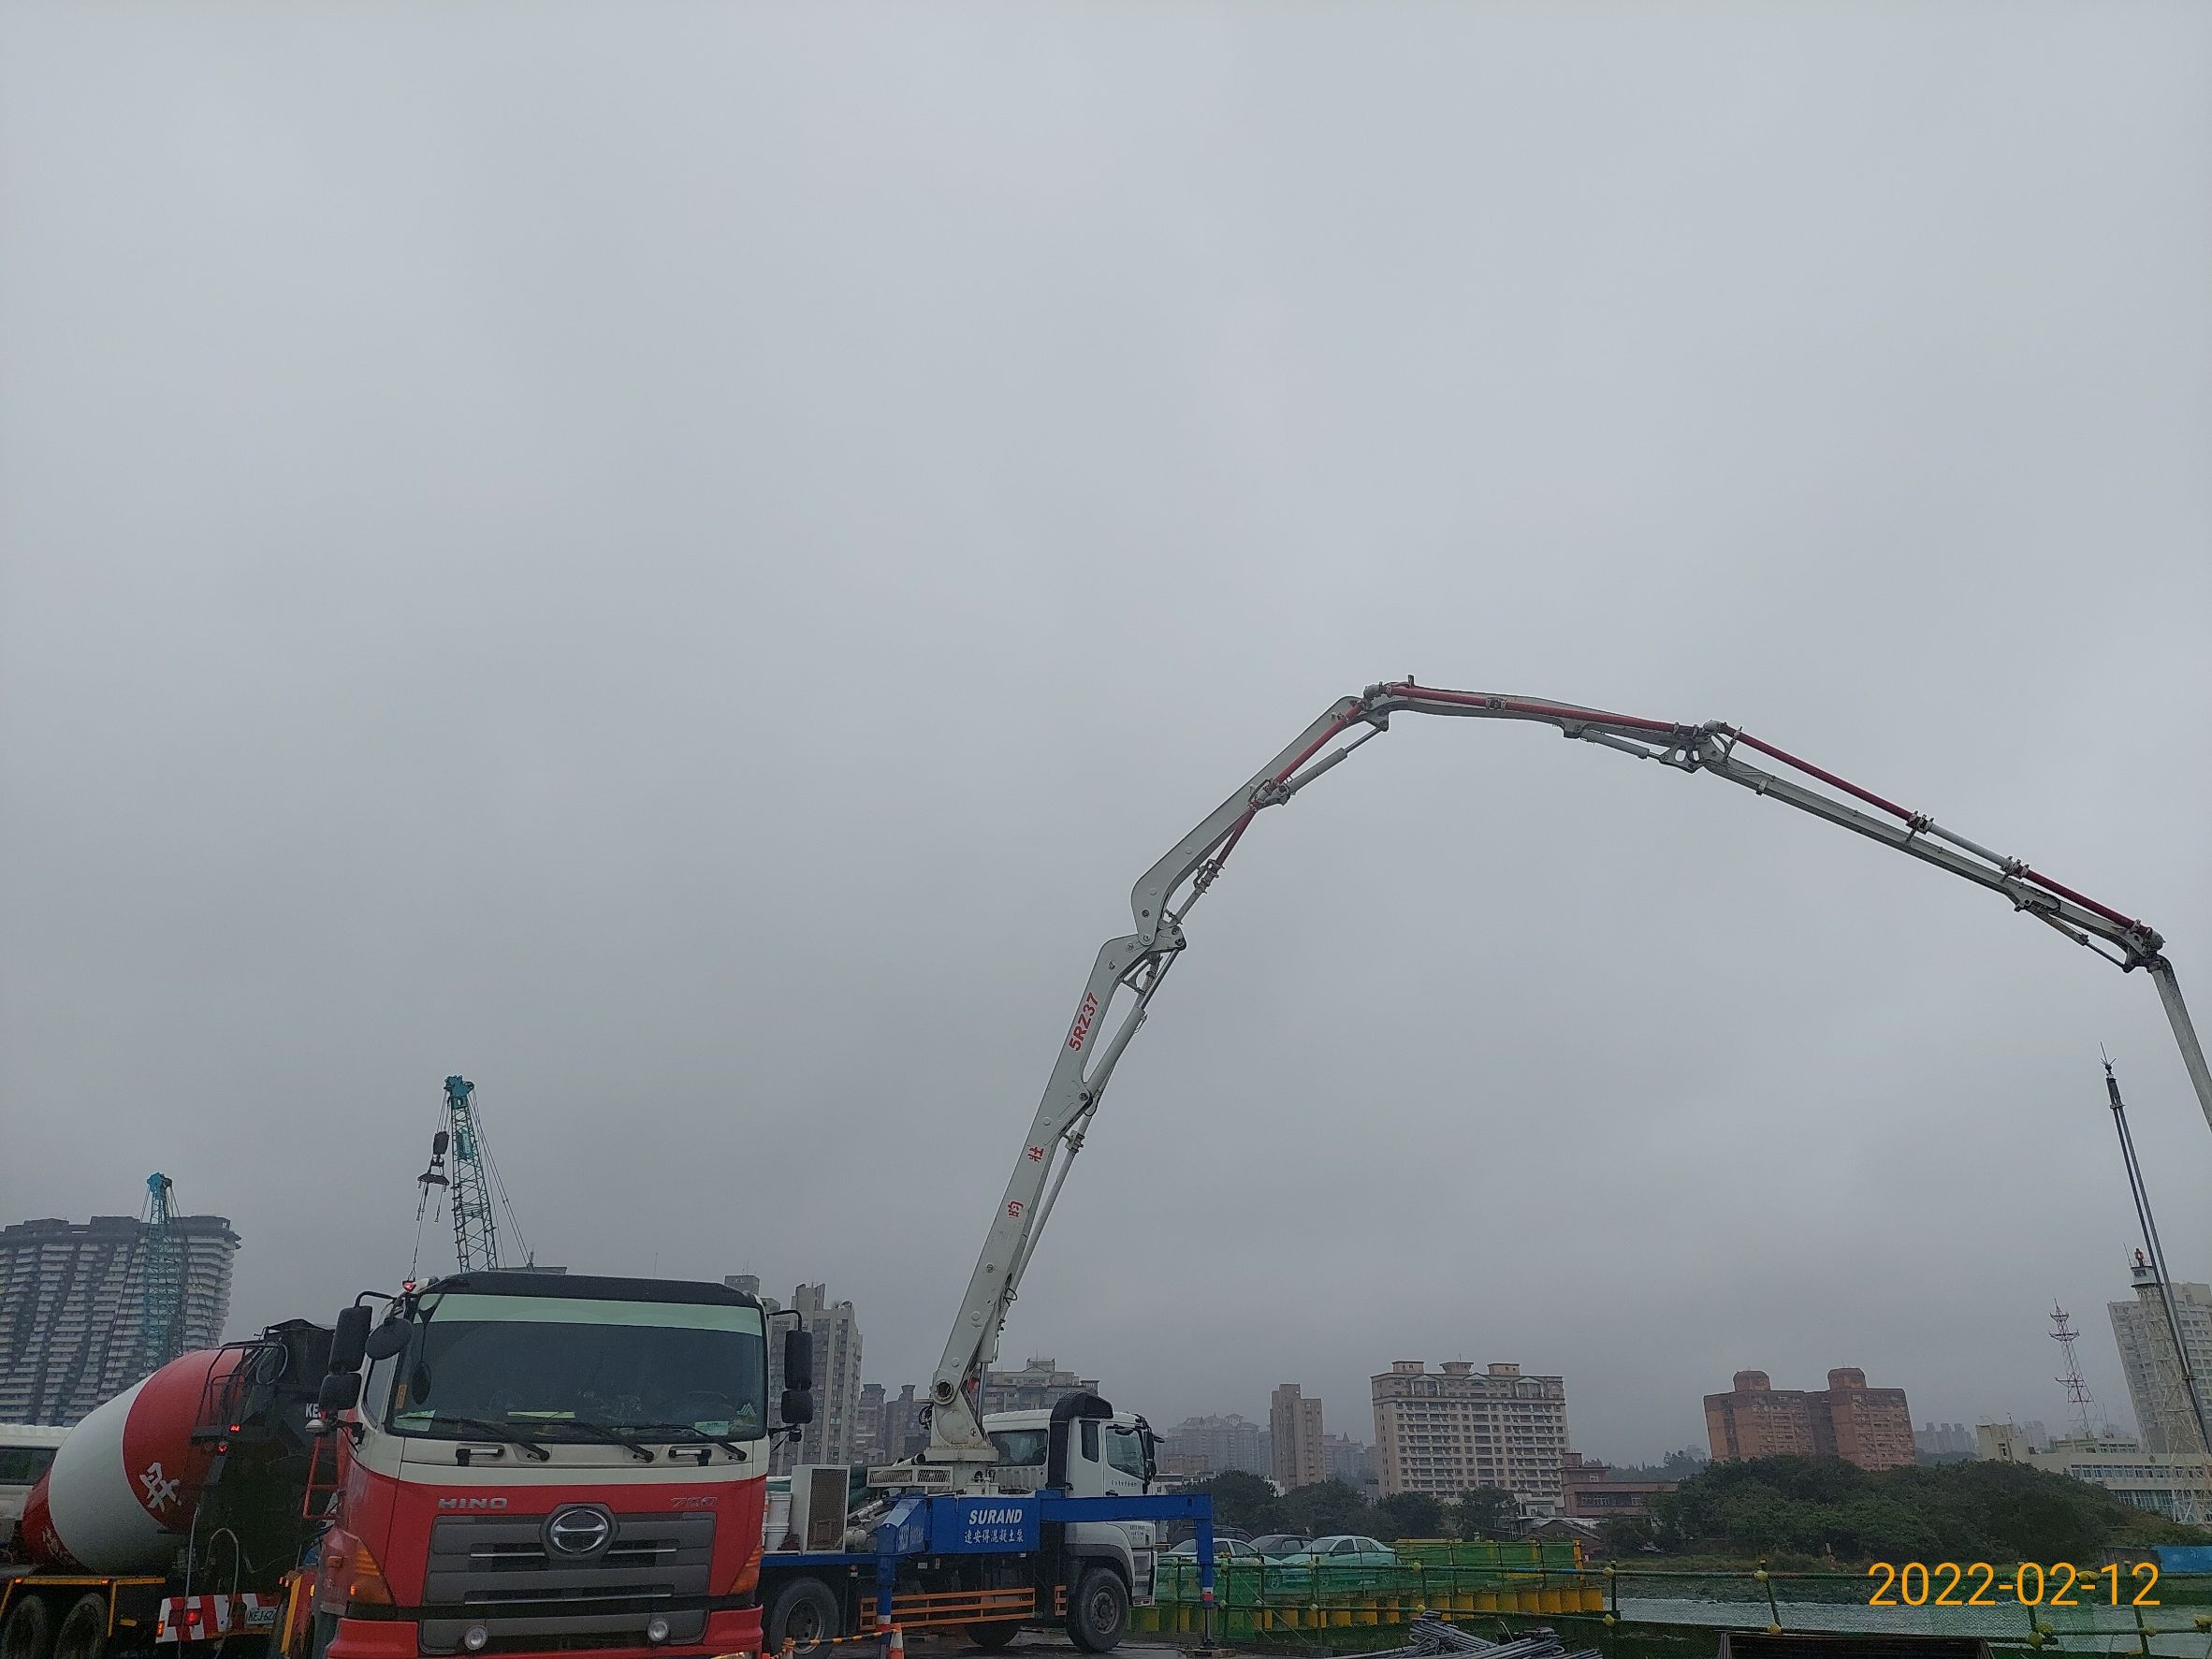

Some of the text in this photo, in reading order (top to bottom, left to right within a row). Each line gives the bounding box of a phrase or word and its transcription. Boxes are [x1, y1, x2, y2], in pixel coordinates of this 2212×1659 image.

[1069, 992, 1099, 1051] 5RZ37
[437, 1497, 508, 1509] HINO
[968, 1508, 1023, 1525] SURAND
